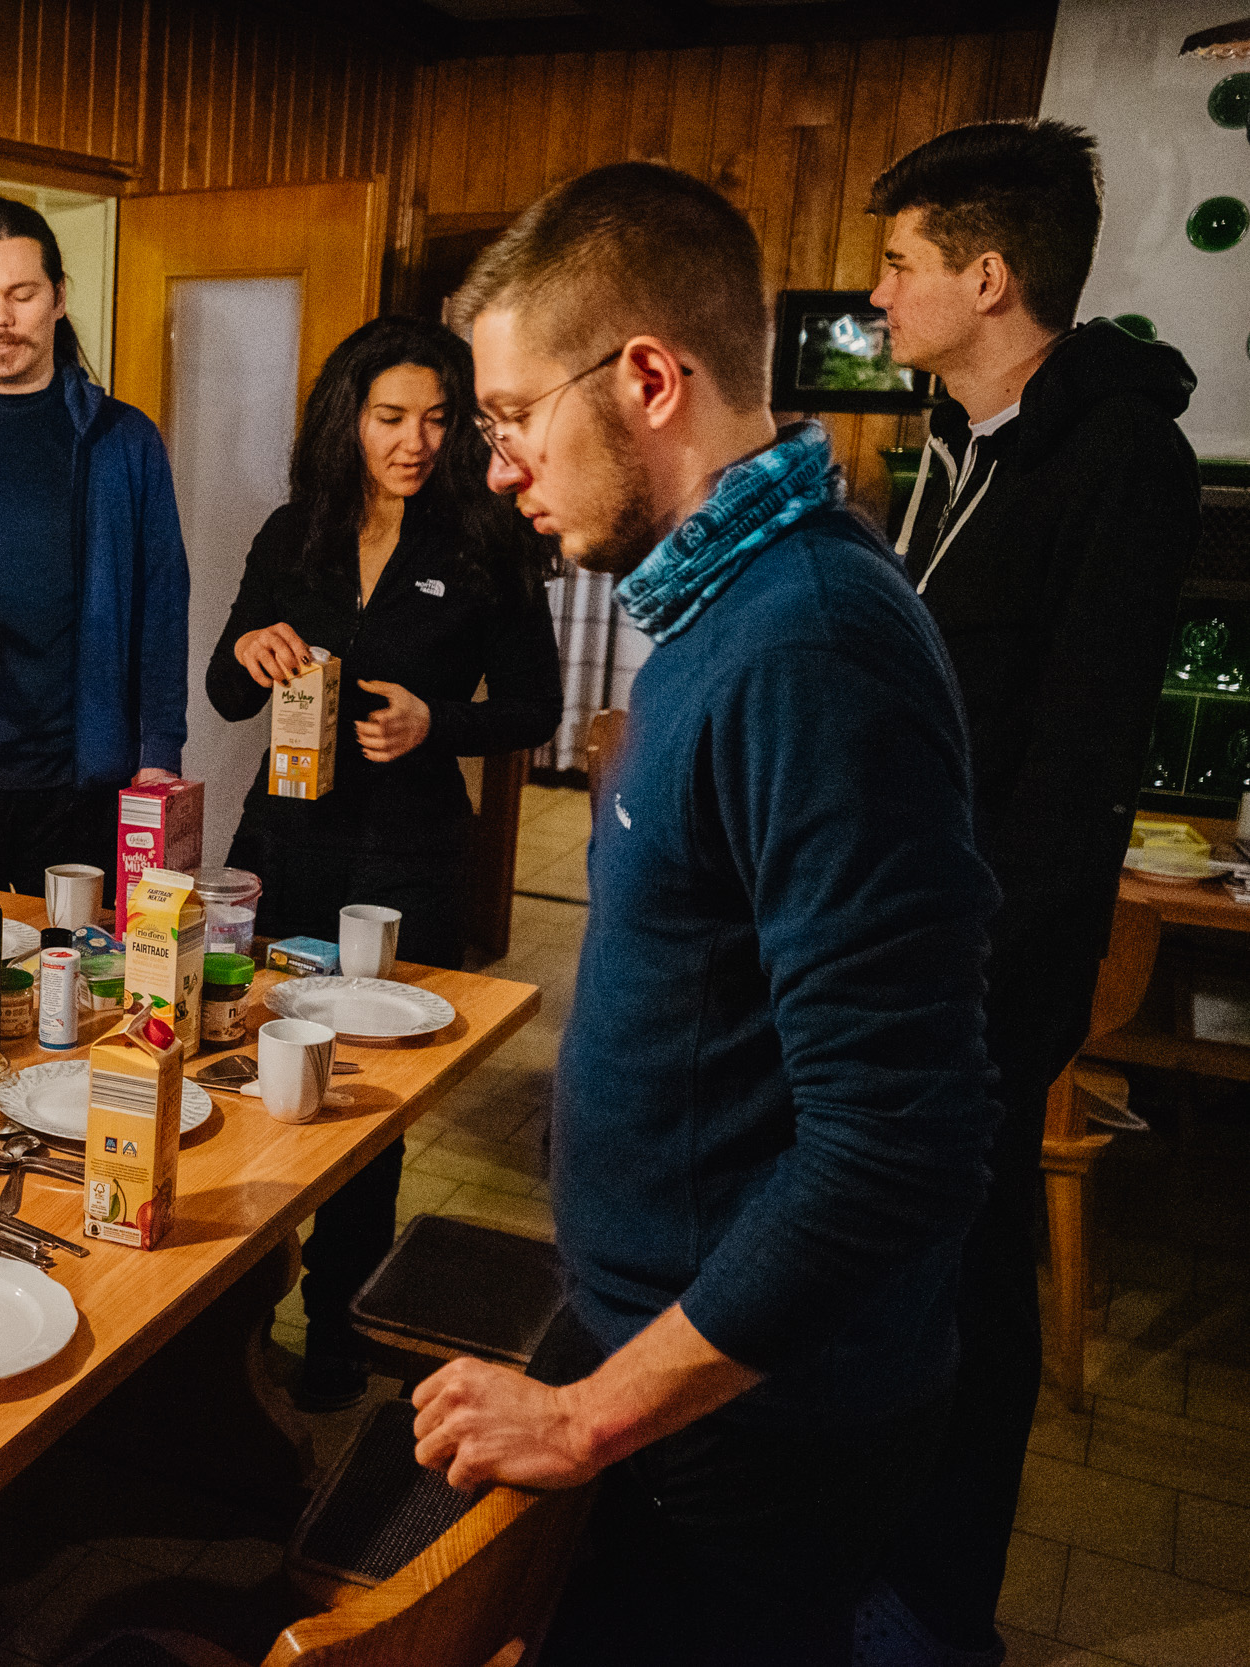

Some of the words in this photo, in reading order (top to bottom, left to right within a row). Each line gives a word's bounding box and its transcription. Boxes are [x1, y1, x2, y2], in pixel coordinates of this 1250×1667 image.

[147, 888, 173, 898] FAIRTRADE
[147, 895, 167, 903] NEKTAR
[137, 929, 147, 938] rio
[132, 941, 169, 959] FAIRTRADE
